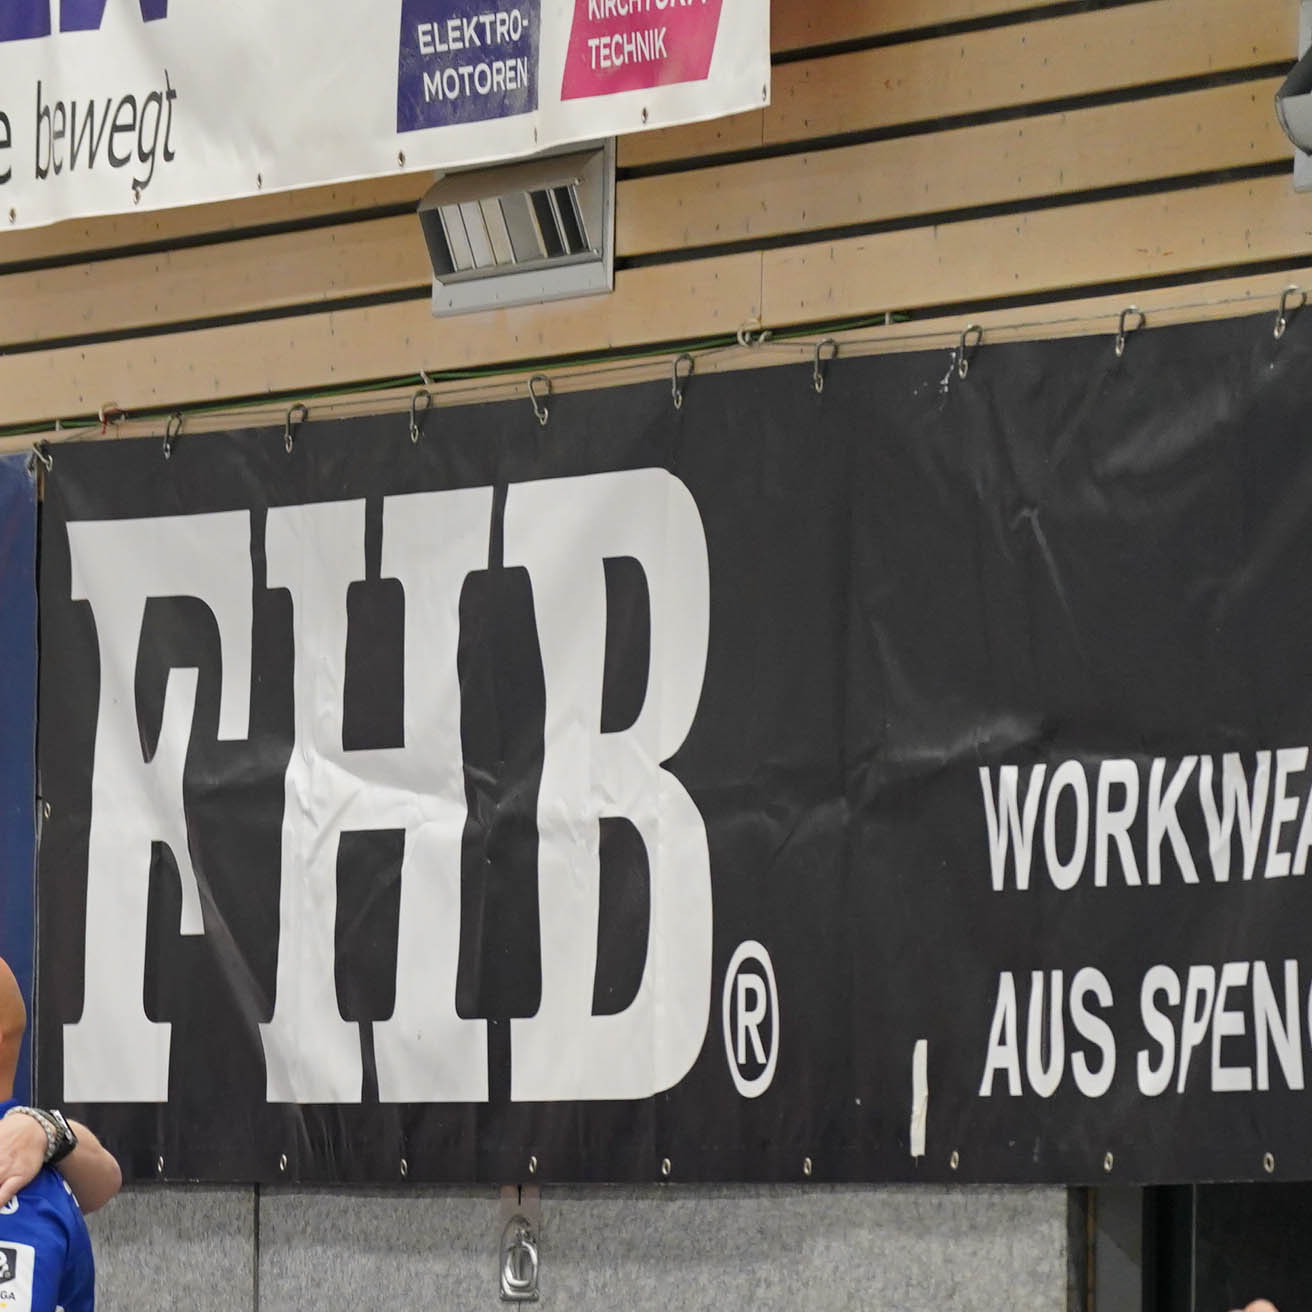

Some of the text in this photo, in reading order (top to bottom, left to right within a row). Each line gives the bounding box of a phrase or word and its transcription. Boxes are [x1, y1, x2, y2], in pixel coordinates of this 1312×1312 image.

[417, 8, 529, 55] ELEKTRO-
[587, 26, 668, 70] TECHNIK
[422, 56, 528, 102] MOTOREN
[34, 68, 178, 196] bewegt
[64, 468, 713, 1102] FHB
[979, 959, 1312, 1098] AUS SPEN
